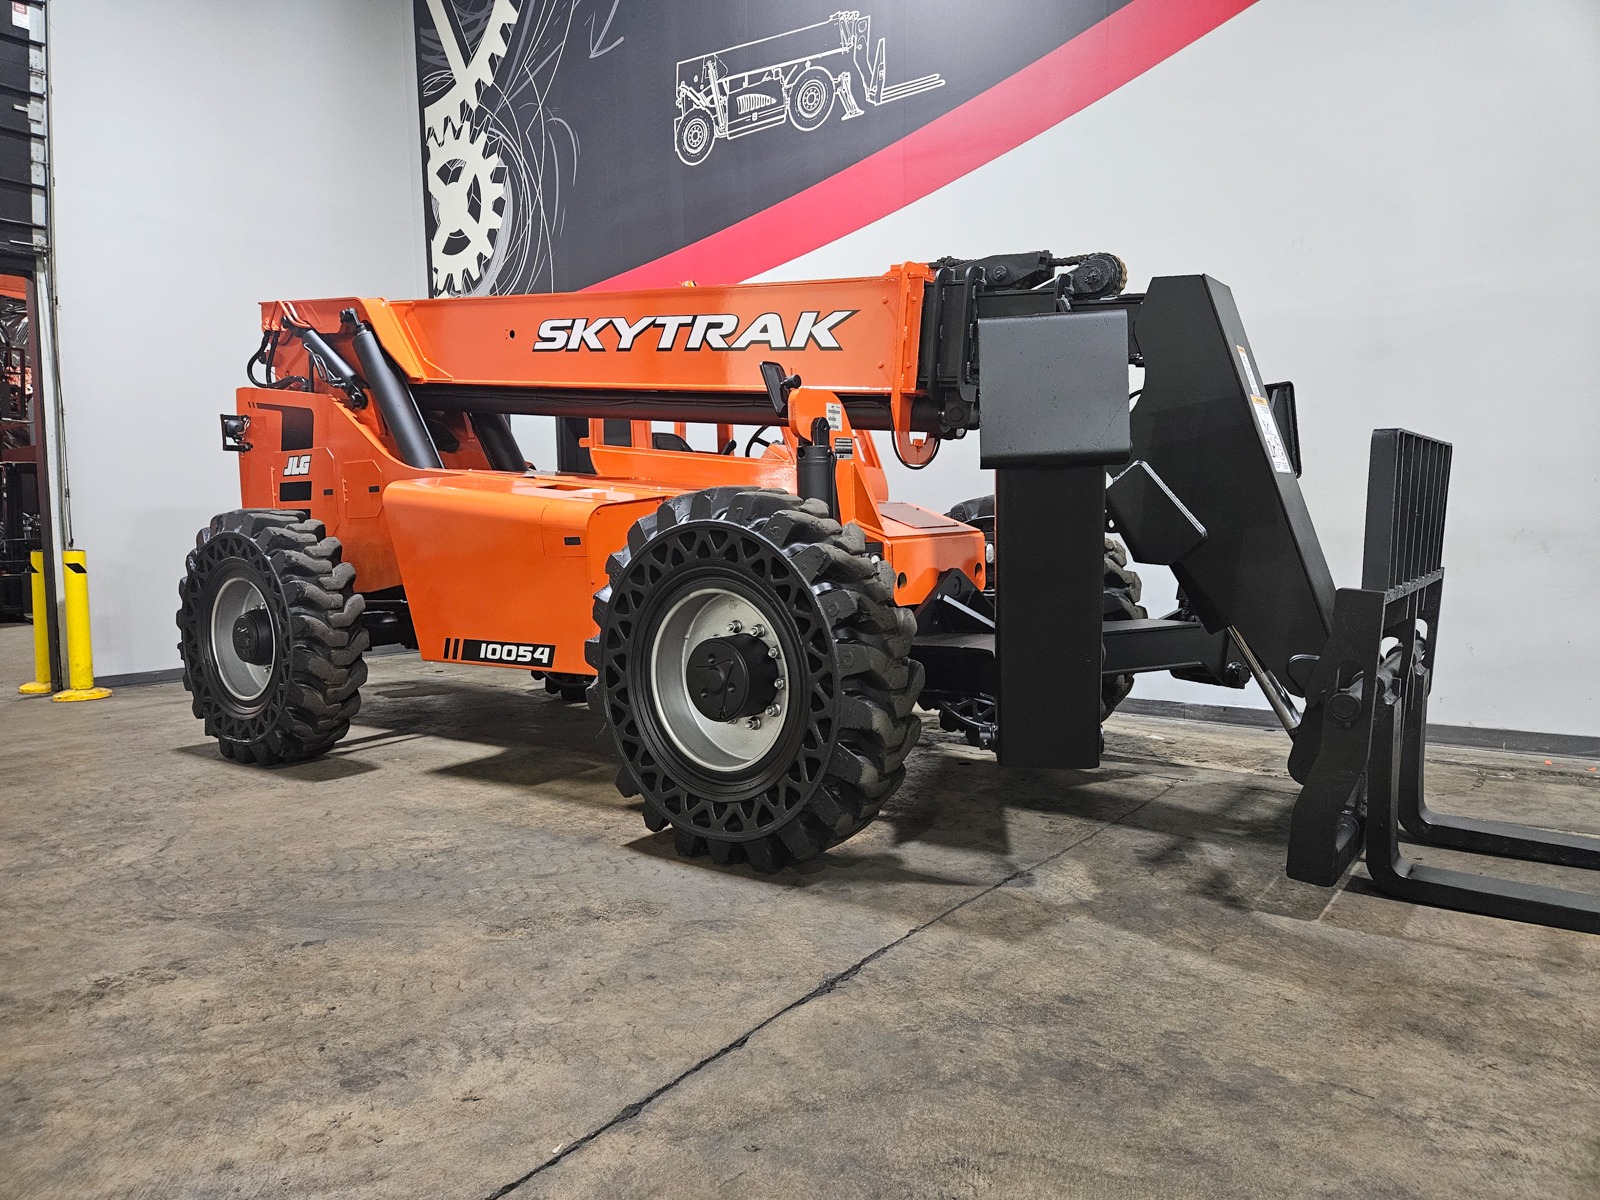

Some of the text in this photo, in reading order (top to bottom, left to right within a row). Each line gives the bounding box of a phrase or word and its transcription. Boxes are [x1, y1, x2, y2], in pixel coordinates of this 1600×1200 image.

[533, 310, 858, 351] SKYTRAK
[283, 455, 311, 476] JLG
[479, 643, 550, 664] 10054
